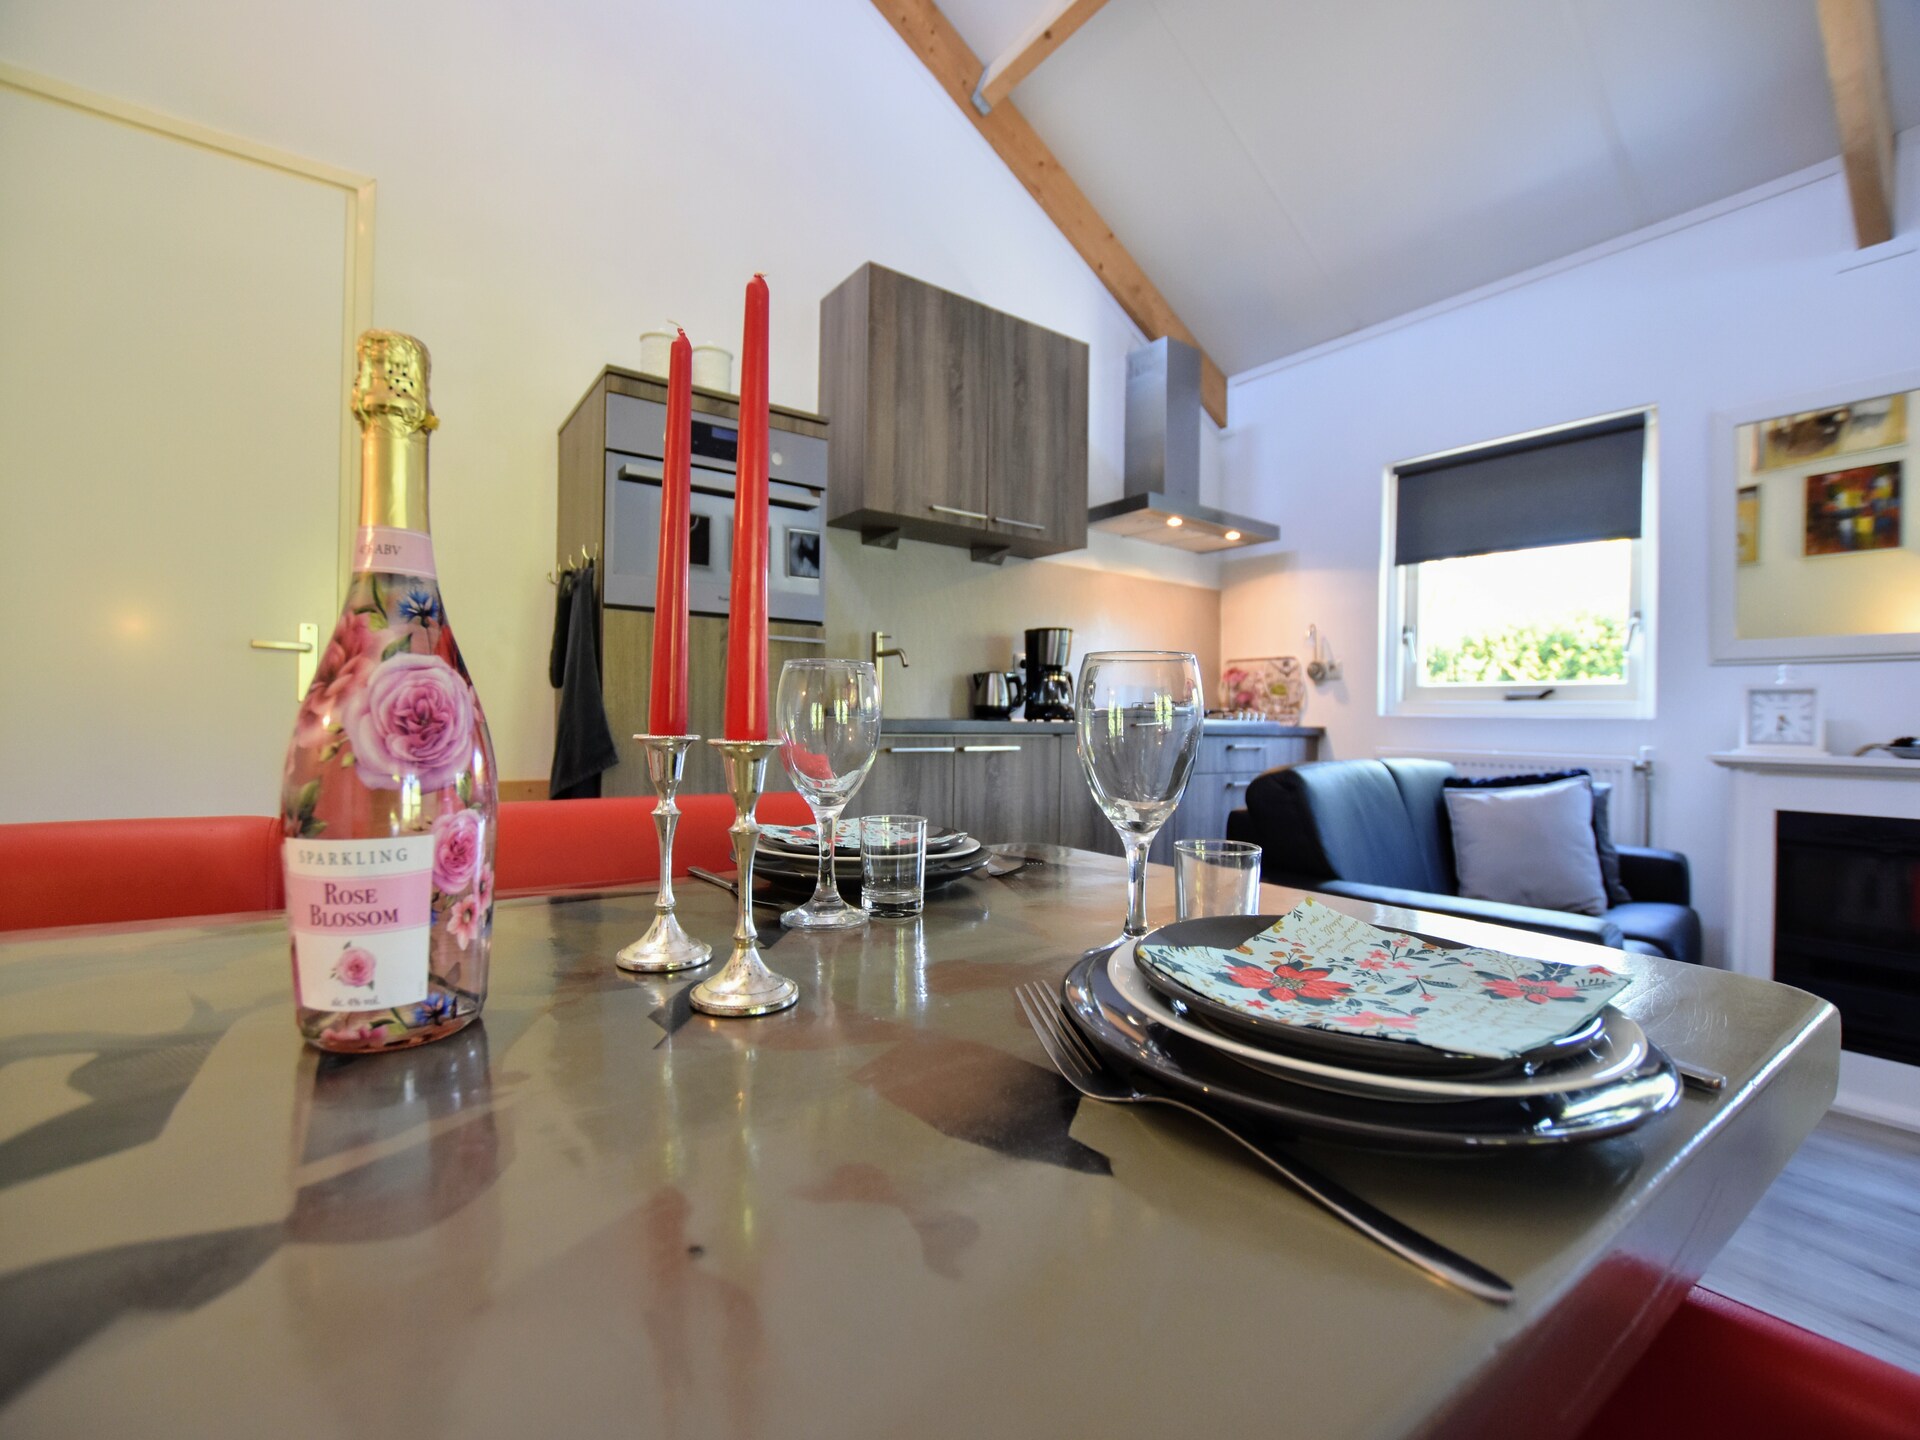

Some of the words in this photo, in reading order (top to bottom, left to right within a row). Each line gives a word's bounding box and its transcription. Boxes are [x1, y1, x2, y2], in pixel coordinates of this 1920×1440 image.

[374, 544, 402, 556] ABV
[298, 848, 408, 865] SPARKLING
[324, 883, 377, 904] ROSE
[310, 904, 398, 927] BLOSSOM
